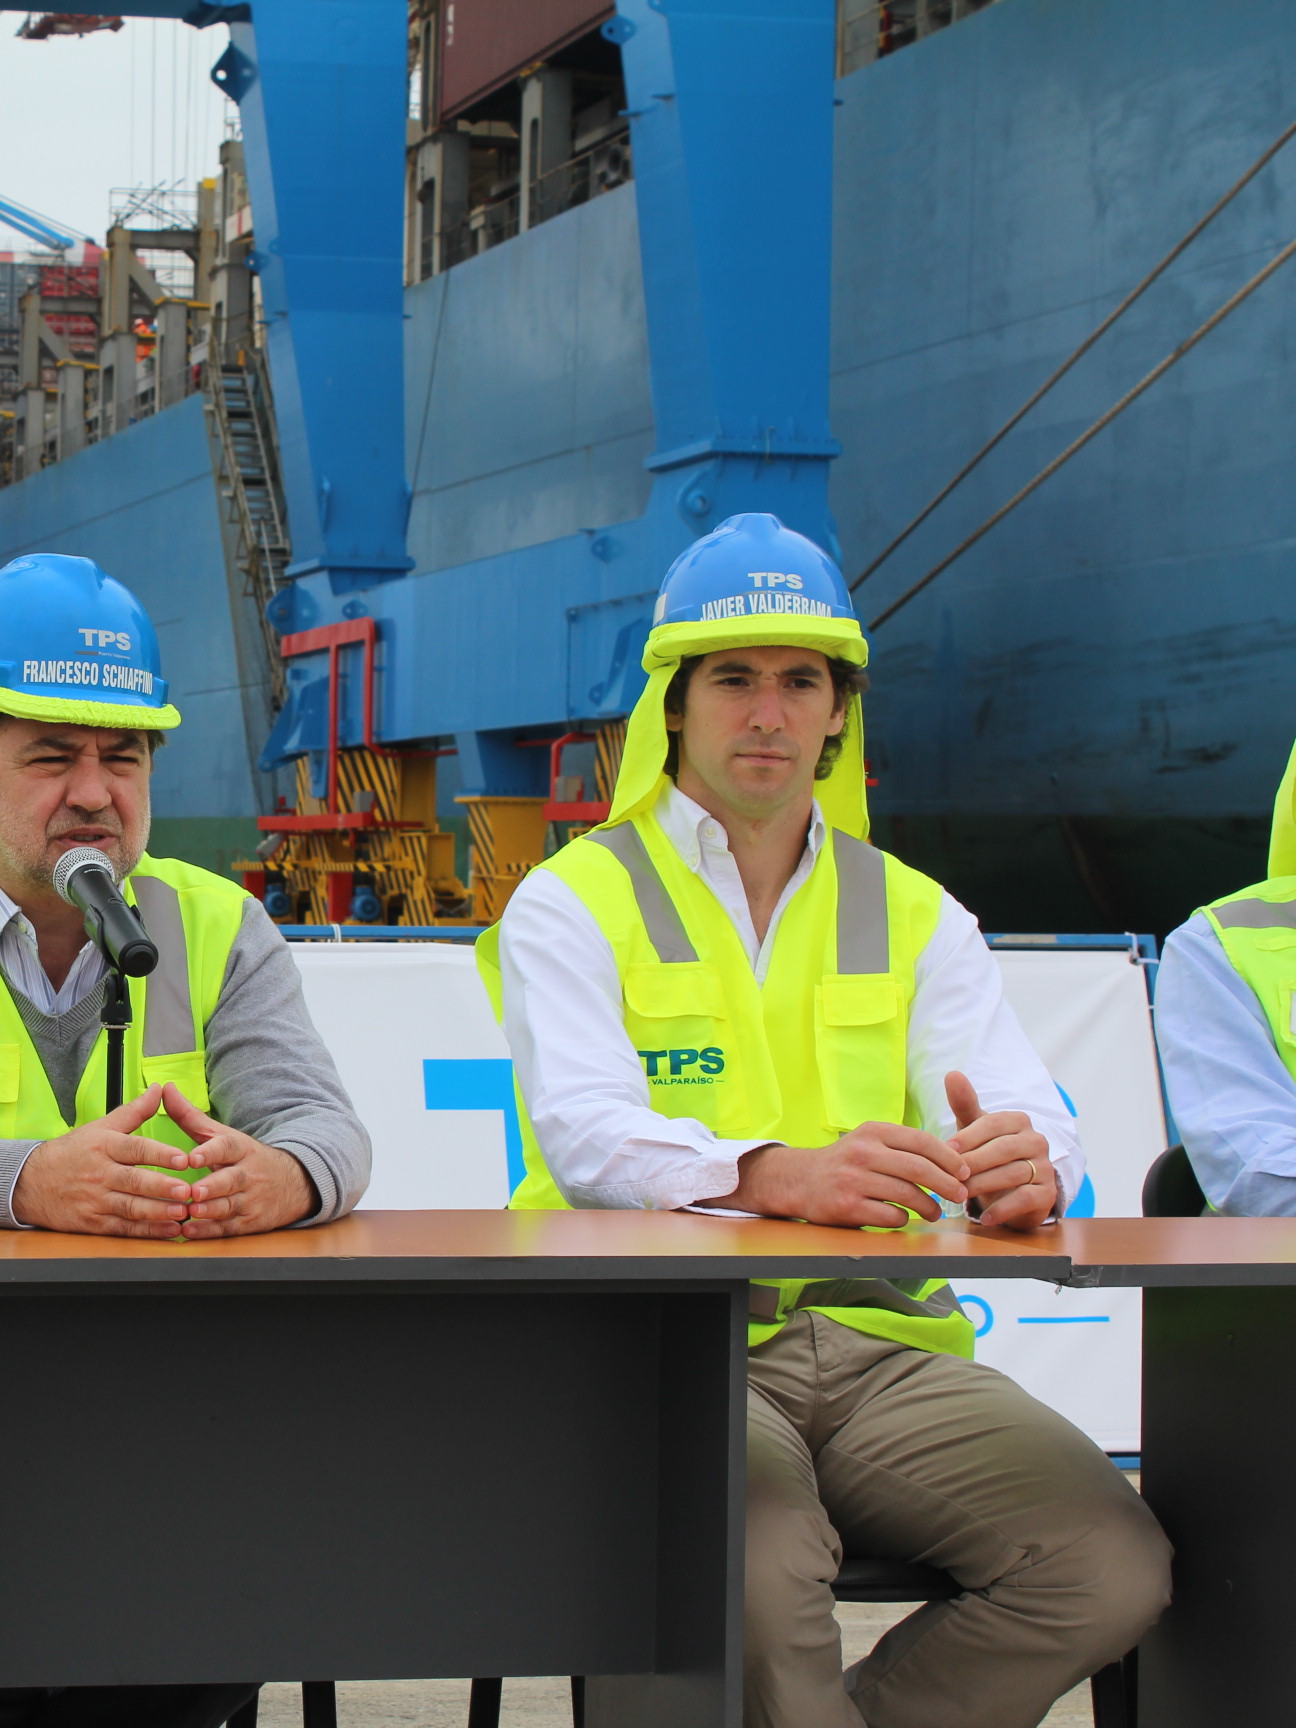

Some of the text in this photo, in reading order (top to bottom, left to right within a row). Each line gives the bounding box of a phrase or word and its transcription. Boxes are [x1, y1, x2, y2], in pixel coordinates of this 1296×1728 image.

[747, 572, 804, 590] TPS
[699, 593, 833, 623] JAVIER VALDERRAMA
[78, 628, 132, 651] TPS
[22, 660, 154, 696] FRANCESCO SCHIAFFINO
[637, 1047, 725, 1076] TPS
[652, 1076, 715, 1086] VALPARAÍSO
